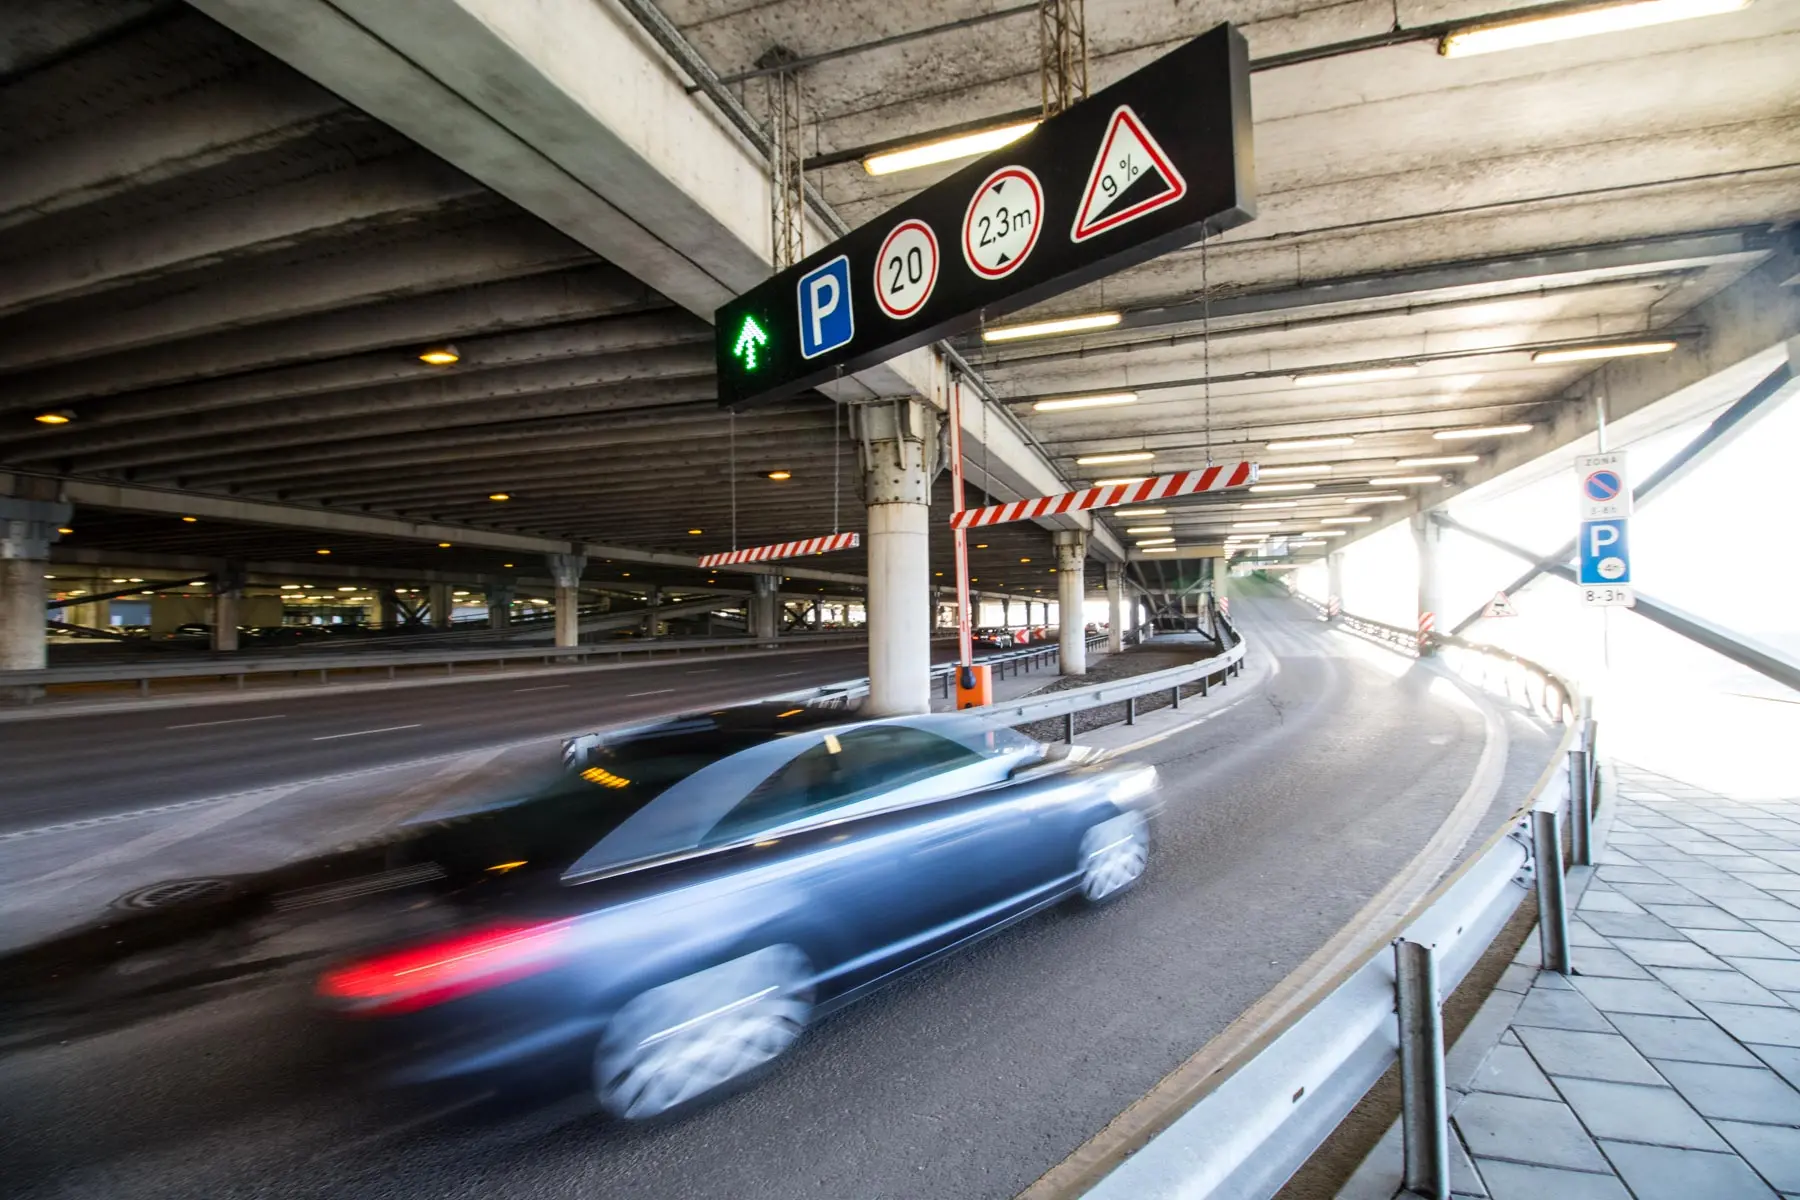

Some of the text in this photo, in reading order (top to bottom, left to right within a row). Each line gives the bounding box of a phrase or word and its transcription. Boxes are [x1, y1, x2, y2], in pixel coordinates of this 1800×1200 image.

[889, 246, 923, 295] 20
[810, 273, 840, 346] P
[1585, 456, 1617, 467] ZONA
[1590, 524, 1619, 557] P
